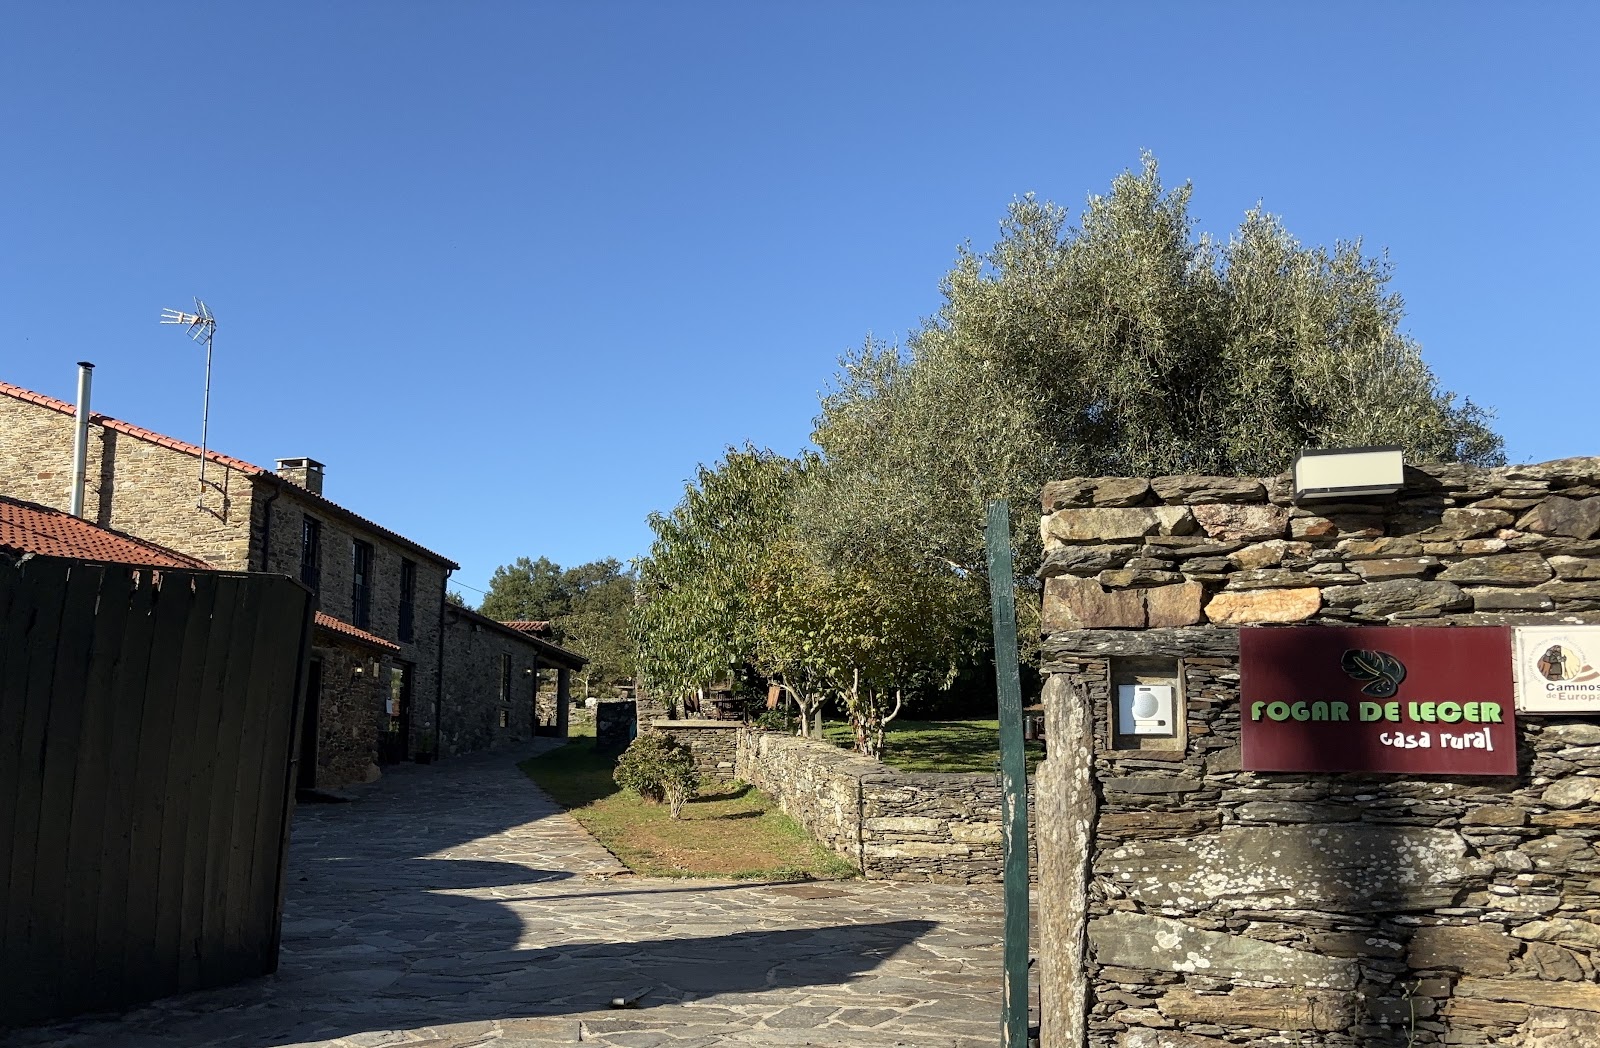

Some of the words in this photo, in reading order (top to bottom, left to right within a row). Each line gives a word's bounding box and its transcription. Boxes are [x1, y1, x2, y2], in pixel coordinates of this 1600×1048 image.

[1251, 701, 1350, 721] FOGAR
[1359, 701, 1400, 722] DE
[1408, 701, 1502, 723] LECER
[1379, 731, 1431, 749] casa
[1440, 727, 1494, 752] rural
